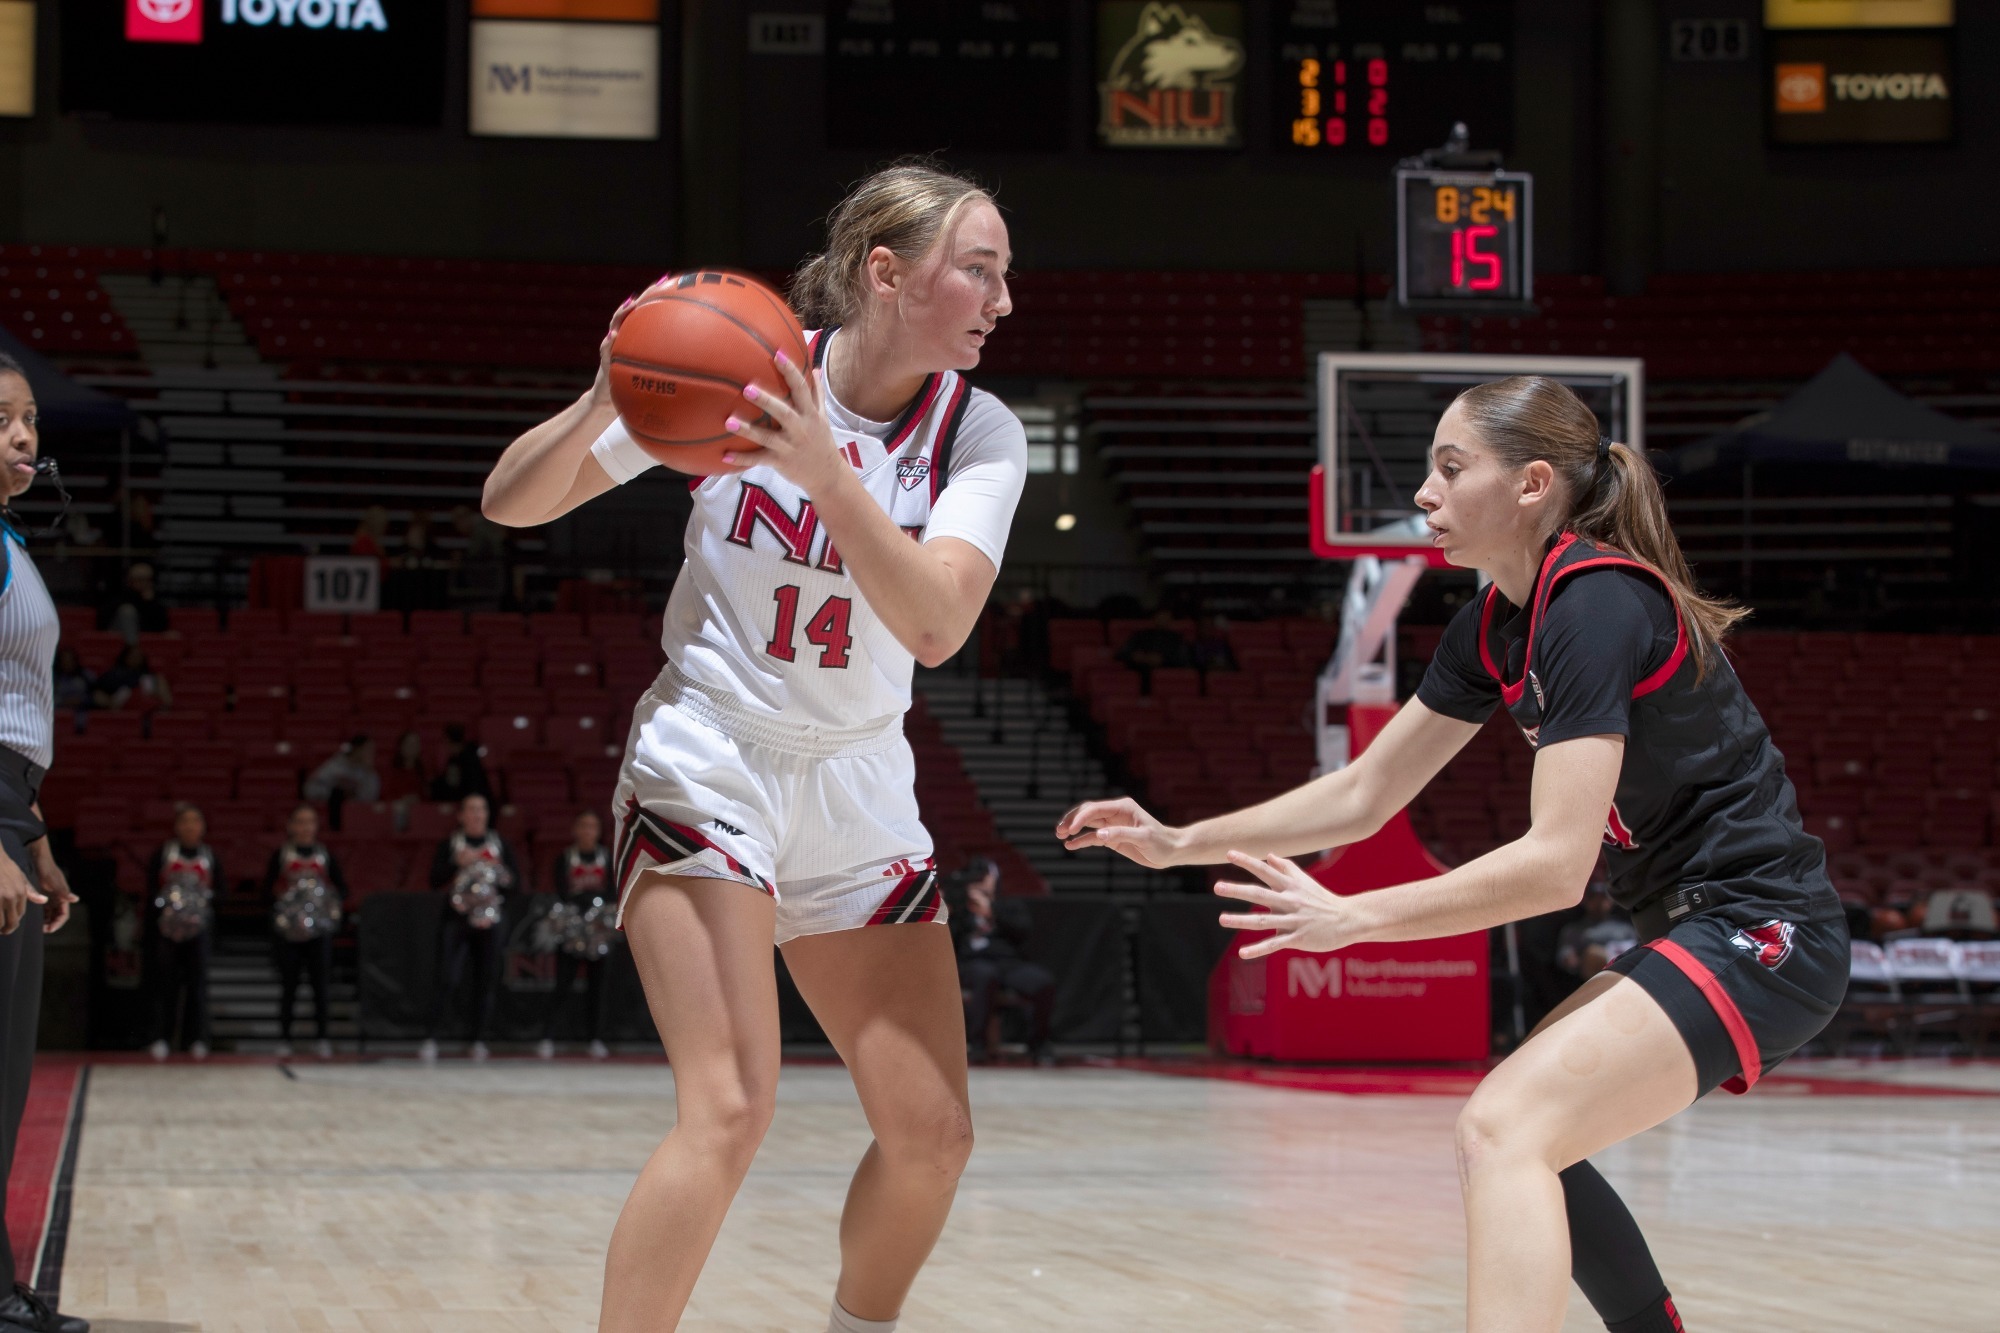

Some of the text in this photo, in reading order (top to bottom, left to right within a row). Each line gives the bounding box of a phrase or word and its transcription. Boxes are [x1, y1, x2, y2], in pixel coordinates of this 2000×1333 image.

[221, 0, 388, 30] TOYOTA
[1334, 59, 1347, 86] 1
[1830, 73, 1950, 101] TOYOTA
[1109, 89, 1224, 128] NIU
[1334, 88, 1347, 115] 1
[1435, 186, 1516, 223] 8:24
[1451, 225, 1502, 290] 15
[640, 377, 676, 395] NFHS
[896, 471, 929, 482] MAC
[314, 567, 370, 602] 107
[766, 583, 853, 669] 14
[1692, 893, 1702, 904] S
[1345, 958, 1477, 978] Northwestern
[1346, 980, 1427, 997] Medicine
